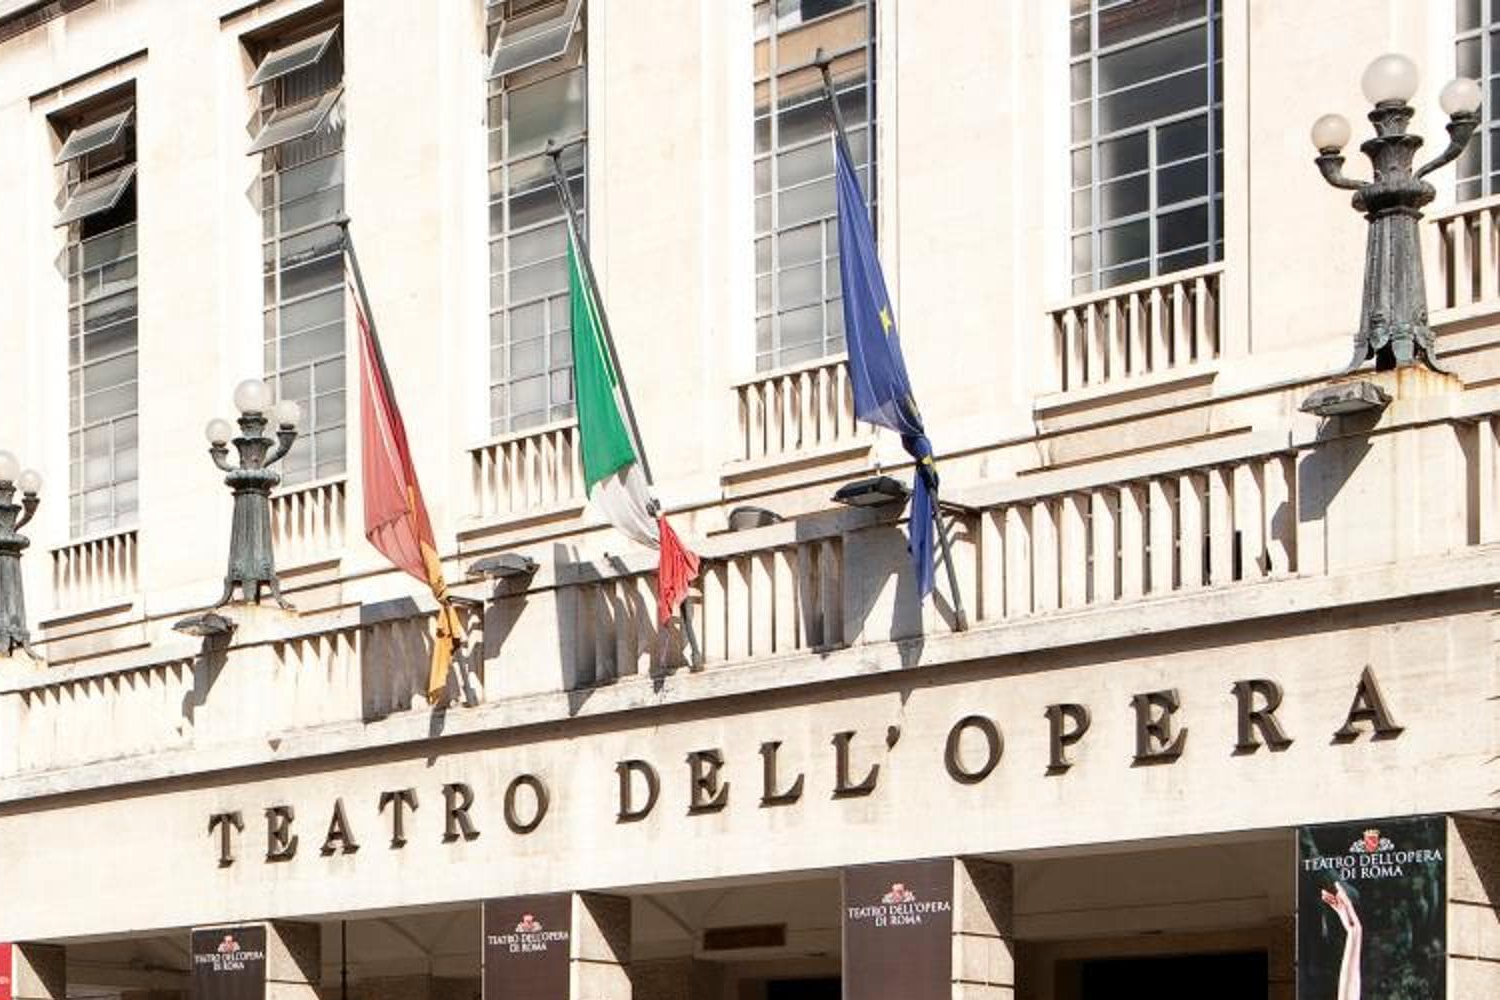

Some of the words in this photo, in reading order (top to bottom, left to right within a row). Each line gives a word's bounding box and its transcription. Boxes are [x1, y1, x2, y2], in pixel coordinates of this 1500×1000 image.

[208, 773, 550, 868] TEATRO
[1304, 856, 1355, 871] TEATRO
[1359, 849, 1443, 867] DELL'OPERA
[1341, 868, 1356, 880] DI
[1361, 866, 1403, 879] ROMA
[848, 905, 887, 919] TEATRO
